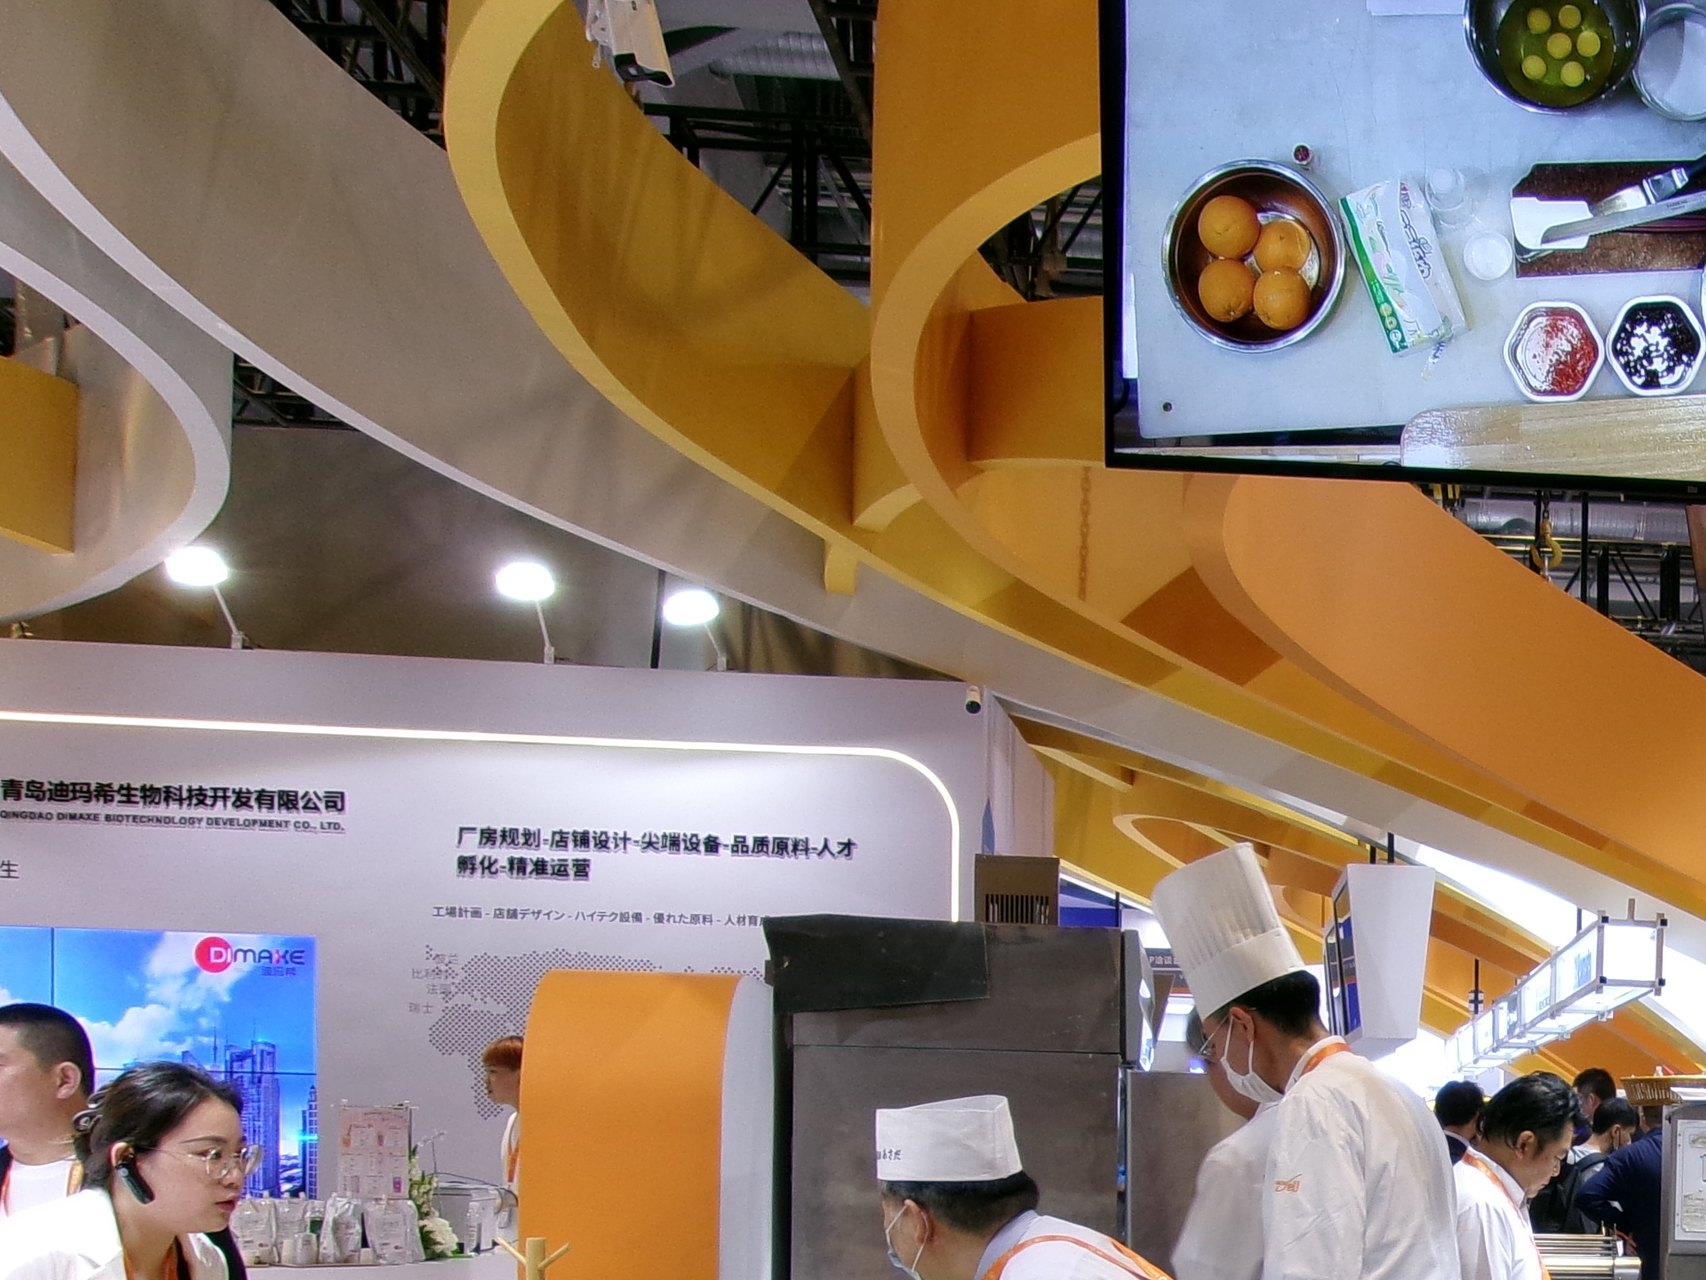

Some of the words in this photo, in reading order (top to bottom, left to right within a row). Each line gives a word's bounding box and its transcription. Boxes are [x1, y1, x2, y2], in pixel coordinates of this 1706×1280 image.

[0, 779, 346, 812] 青岛迪玛希生物科技开发有限公司
[0, 810, 53, 820] QINGDAO
[57, 812, 100, 822] DIMAXE
[104, 814, 203, 825] BIOTECHNOLOGY
[206, 817, 289, 828] DEVELOPMENT
[320, 822, 345, 831] LTD.
[0, 860, 19, 879] 生
[209, 946, 305, 965] DIMAXE
